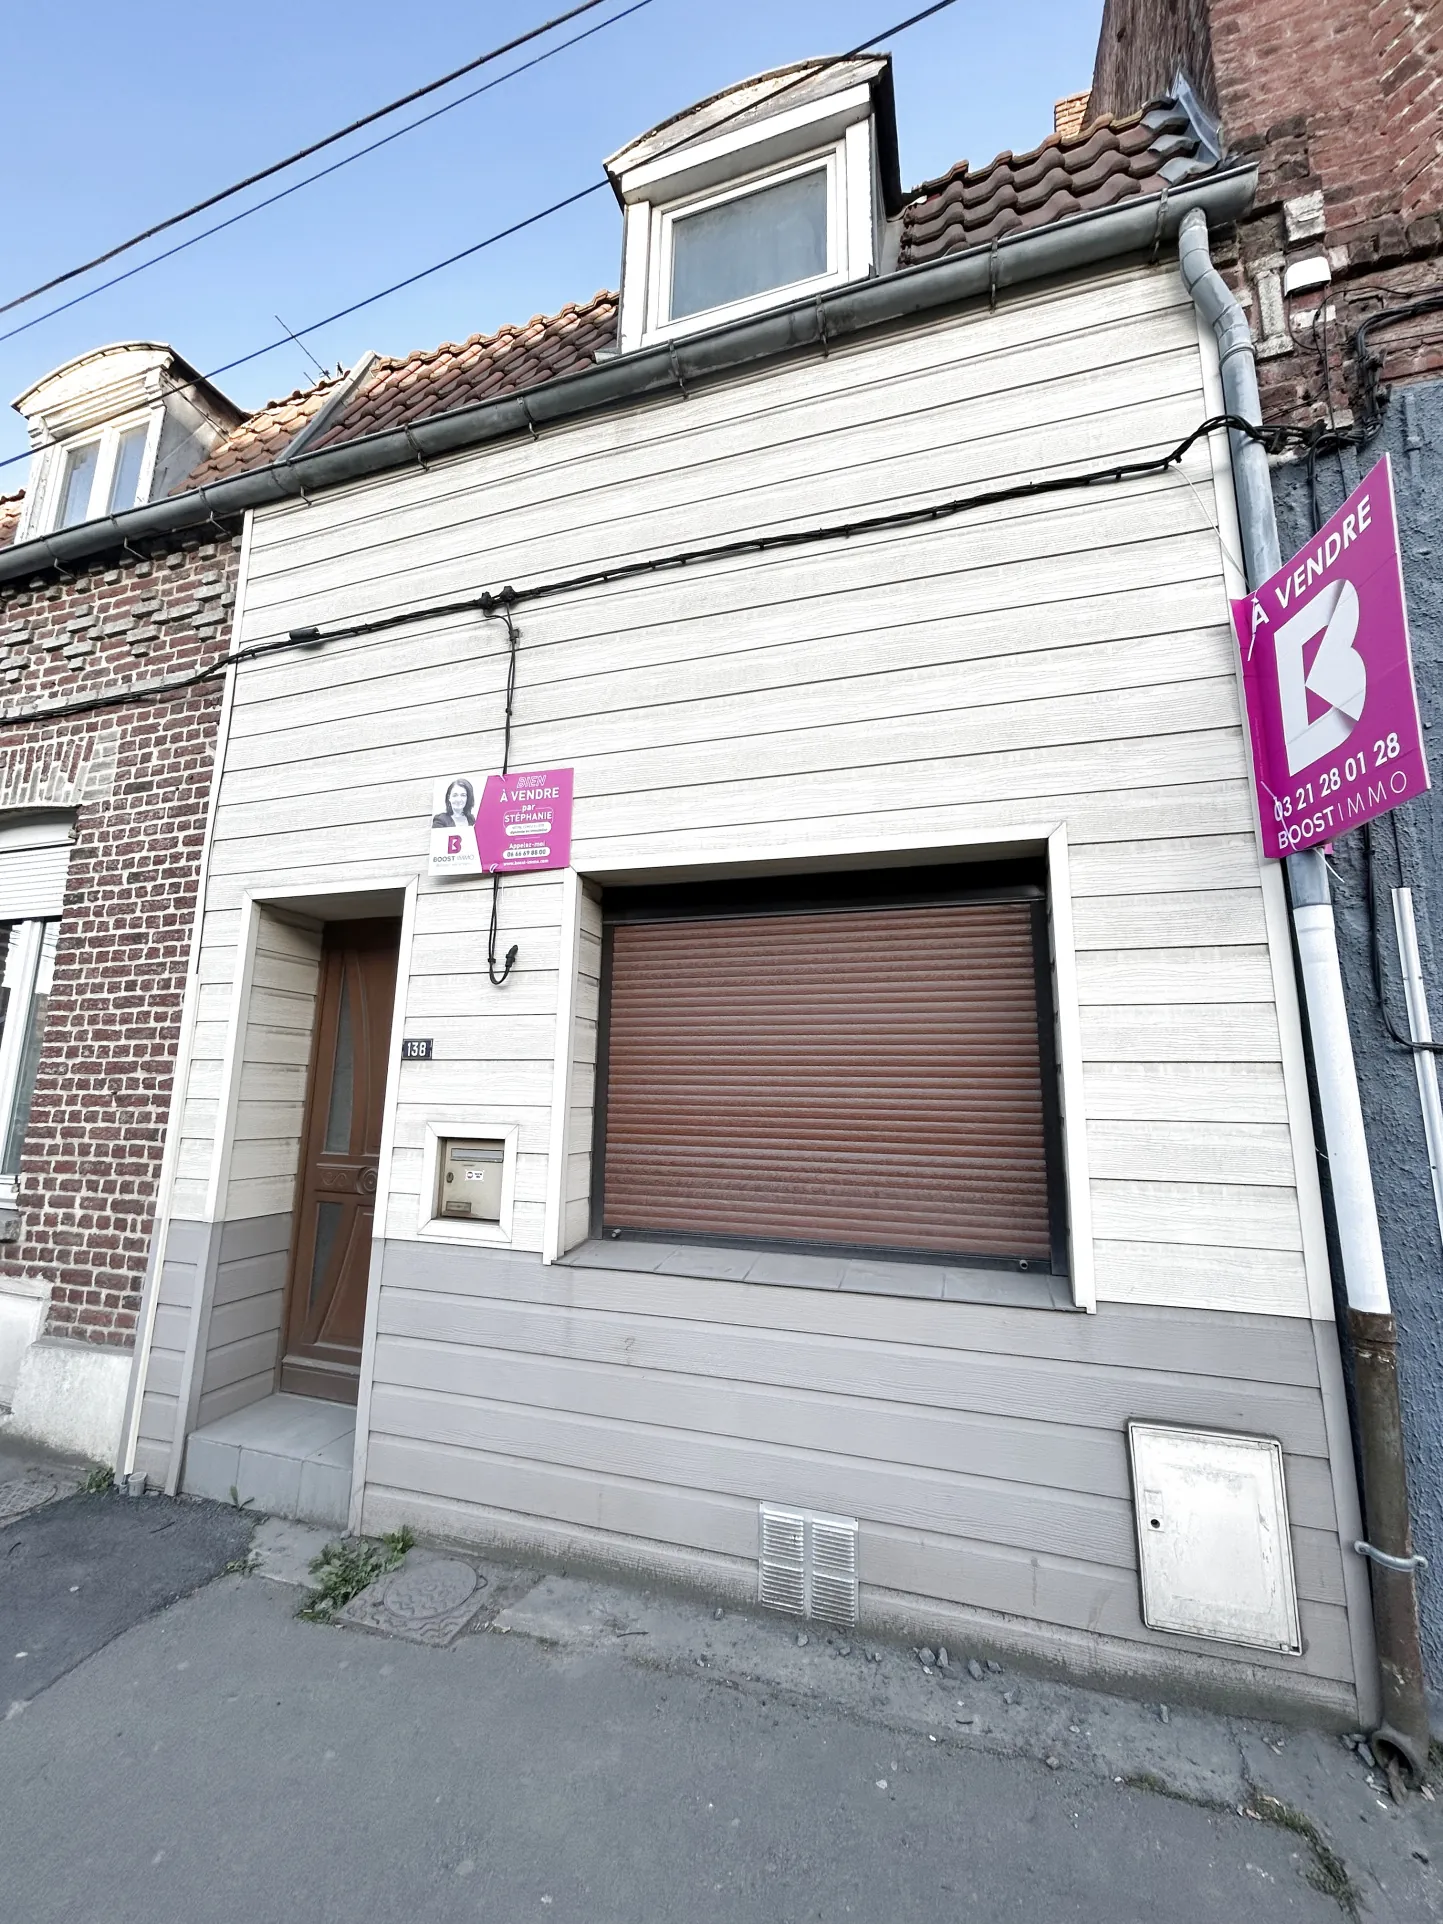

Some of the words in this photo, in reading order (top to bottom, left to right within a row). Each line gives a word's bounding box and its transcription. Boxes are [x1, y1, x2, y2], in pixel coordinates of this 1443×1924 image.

[1252, 596, 1270, 635] À
[1274, 494, 1372, 609] VENDRE
[516, 775, 547, 789] BIEN
[1274, 796, 1293, 822] 03
[1295, 783, 1314, 810] 21
[1319, 767, 1341, 797] 28
[1344, 751, 1367, 782] 01
[1373, 732, 1401, 767] 28
[500, 789, 508, 803] À
[511, 787, 560, 801] VENDRE
[522, 804, 536, 813] par
[504, 811, 553, 823] STÉPHANIE
[508, 840, 547, 851] Appelez-moi
[433, 855, 455, 863] BOOST
[407, 1041, 427, 1057] 138
